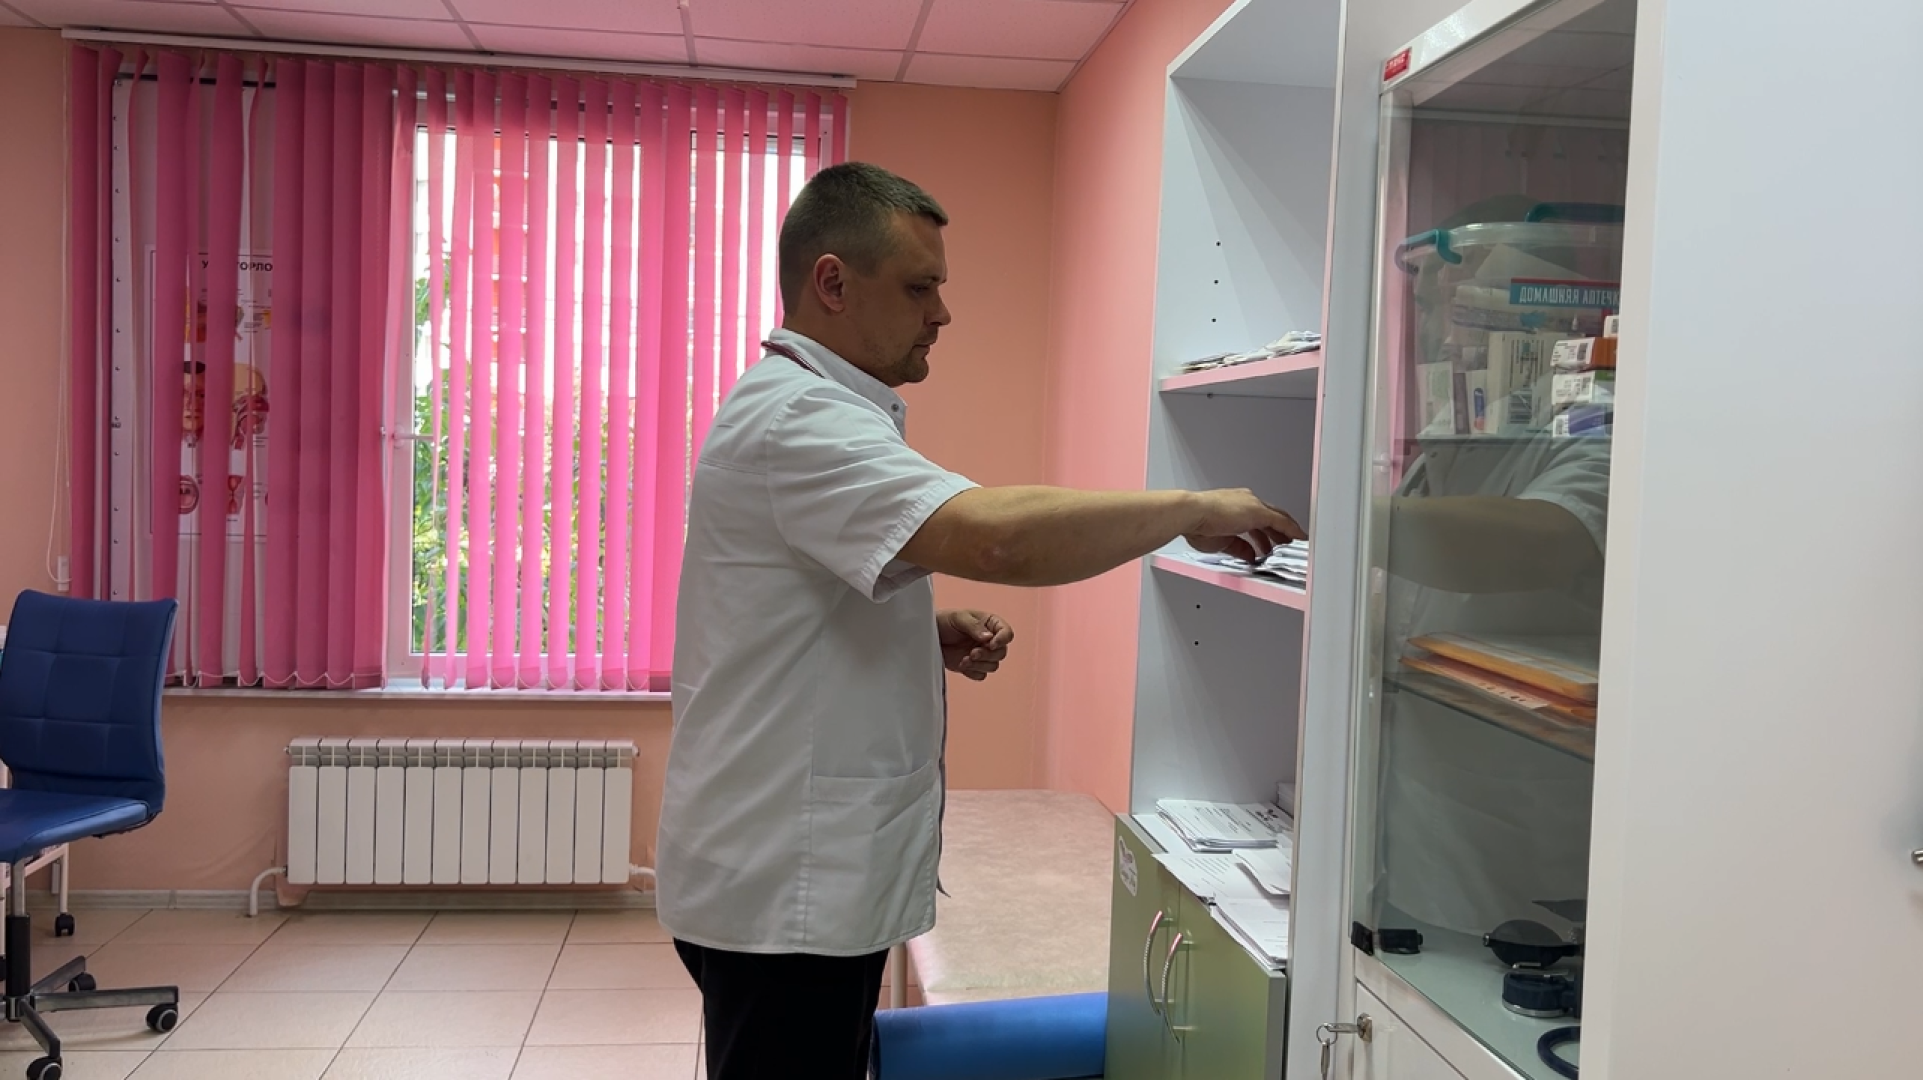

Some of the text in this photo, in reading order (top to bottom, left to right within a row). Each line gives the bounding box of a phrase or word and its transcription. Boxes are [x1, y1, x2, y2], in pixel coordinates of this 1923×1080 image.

[236, 261, 273, 272] ОРЛО
[1519, 286, 1620, 307] ДОМАШНЯЯ АПТЕЧК
